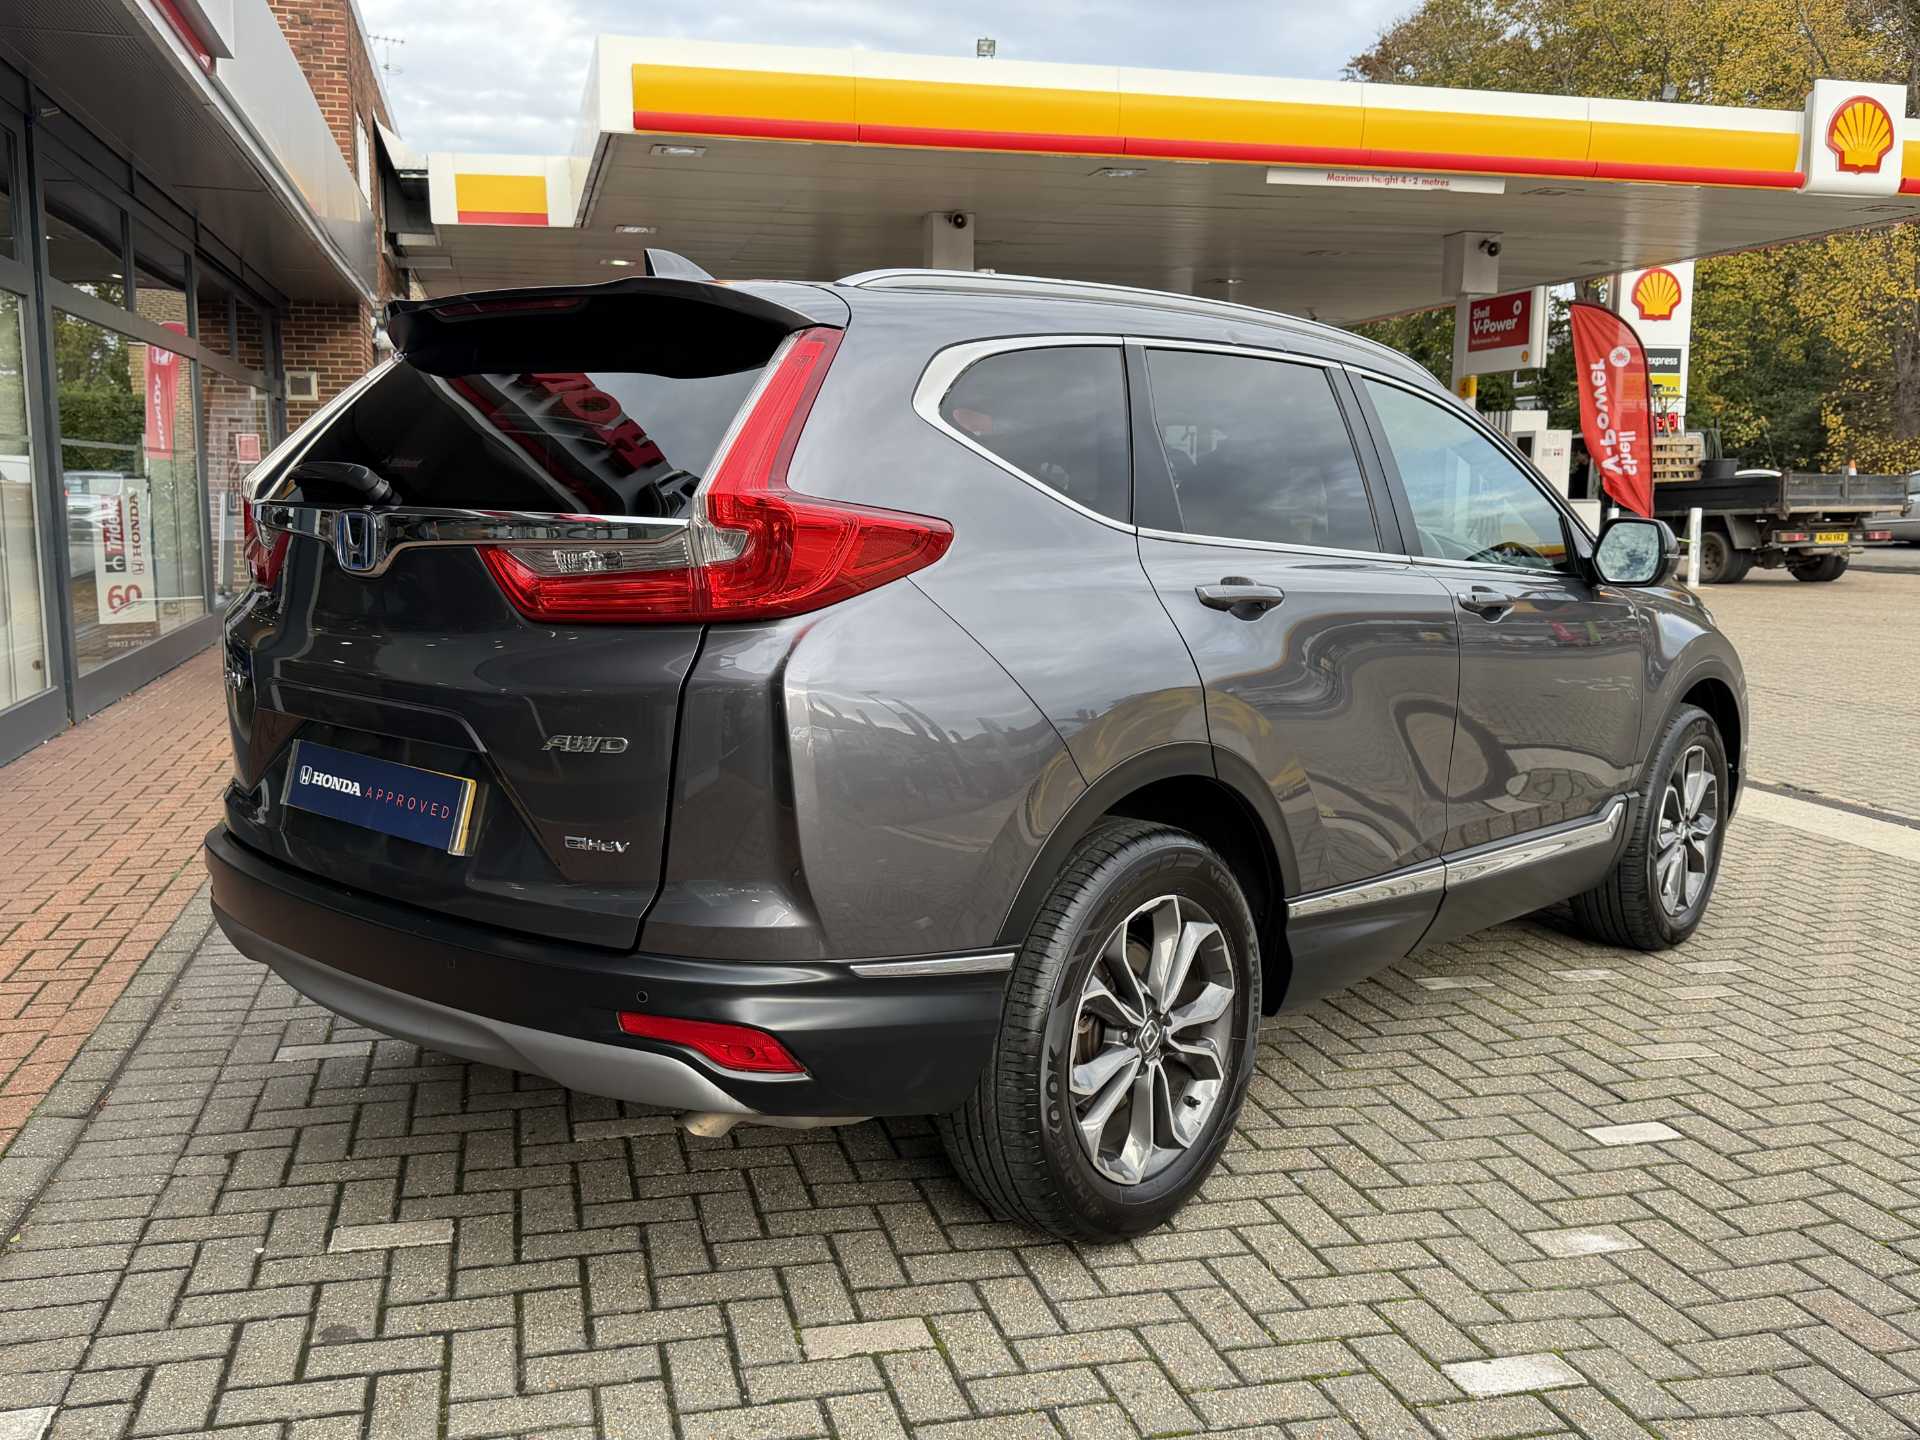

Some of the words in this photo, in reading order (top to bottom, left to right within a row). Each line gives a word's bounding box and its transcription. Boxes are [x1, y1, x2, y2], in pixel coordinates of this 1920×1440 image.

[1326, 172, 1370, 184] Maximum
[1421, 178, 1450, 187] metres
[1473, 305, 1491, 320] Shell
[1473, 317, 1518, 336] V-Power
[129, 491, 143, 561] HONDA
[541, 734, 629, 753] AWD
[311, 771, 361, 797] HONDA
[365, 786, 450, 819] APPROVED
